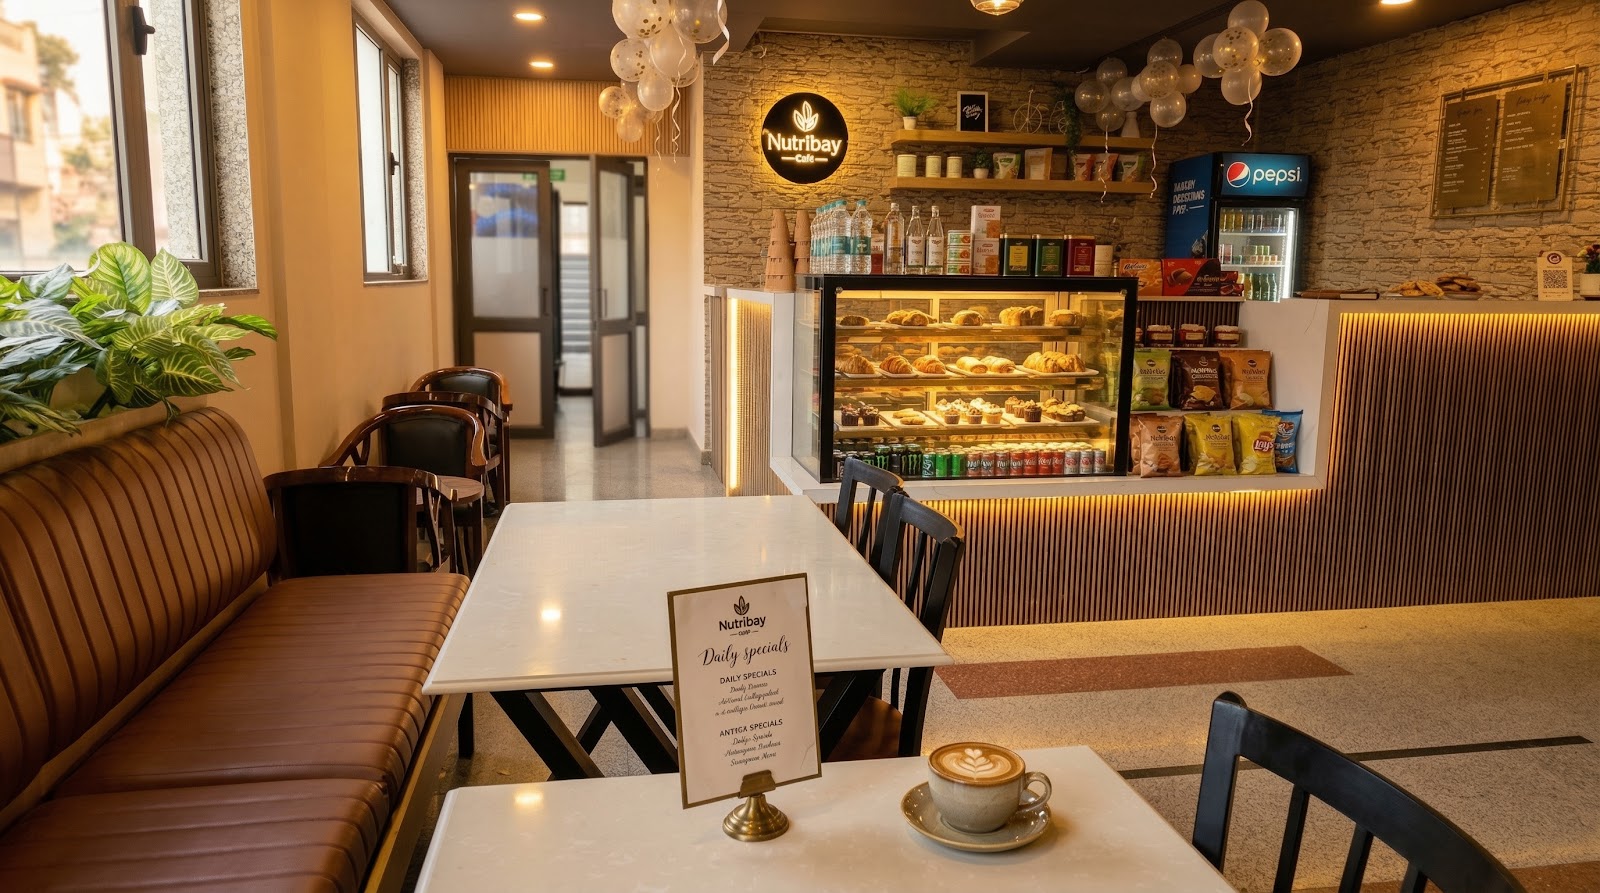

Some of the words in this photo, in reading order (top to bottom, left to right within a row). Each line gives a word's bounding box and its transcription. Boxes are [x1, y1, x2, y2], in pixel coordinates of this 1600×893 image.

[767, 133, 843, 157] Nutribay
[1252, 166, 1301, 186] pepsi
[719, 616, 767, 631] Nutribay
[698, 643, 741, 669] Daily
[743, 634, 791, 665] specials
[720, 674, 742, 684] DAILY
[743, 668, 777, 680] SPECIALS
[749, 718, 783, 731] SPECIALS
